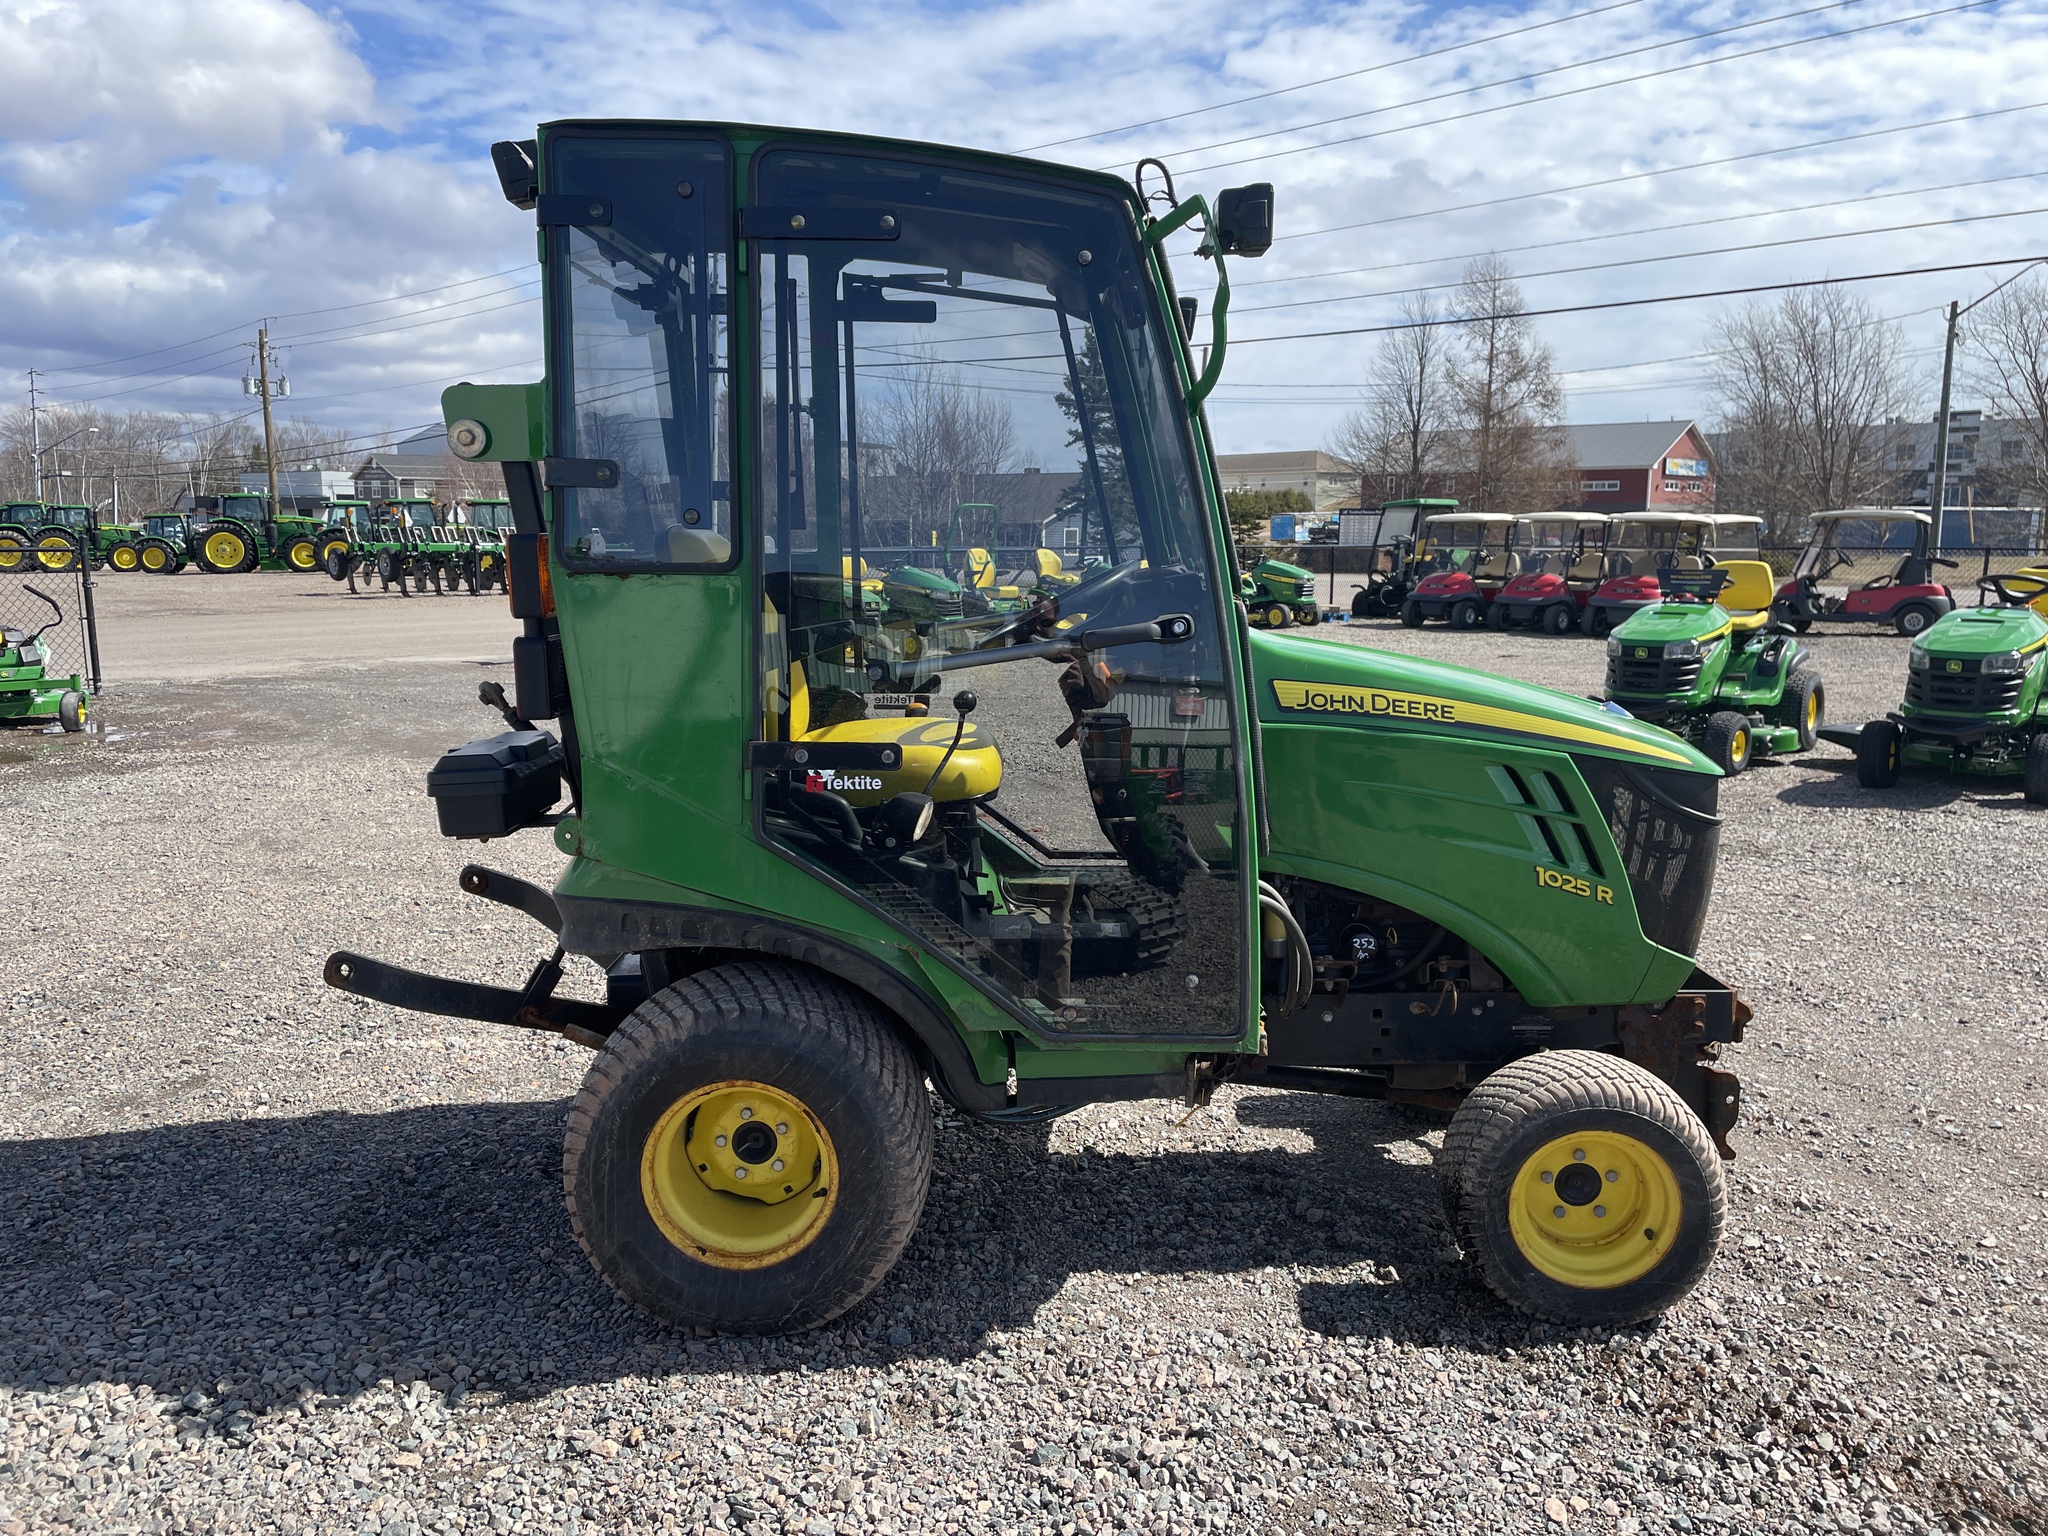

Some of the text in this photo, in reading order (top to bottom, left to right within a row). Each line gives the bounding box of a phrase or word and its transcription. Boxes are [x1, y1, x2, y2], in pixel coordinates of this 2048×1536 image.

[1296, 689, 1455, 720] JOHN DEERE
[827, 775, 882, 790] Tektite
[1534, 866, 1614, 905] 1025 R
[1352, 938, 1376, 950] 252
